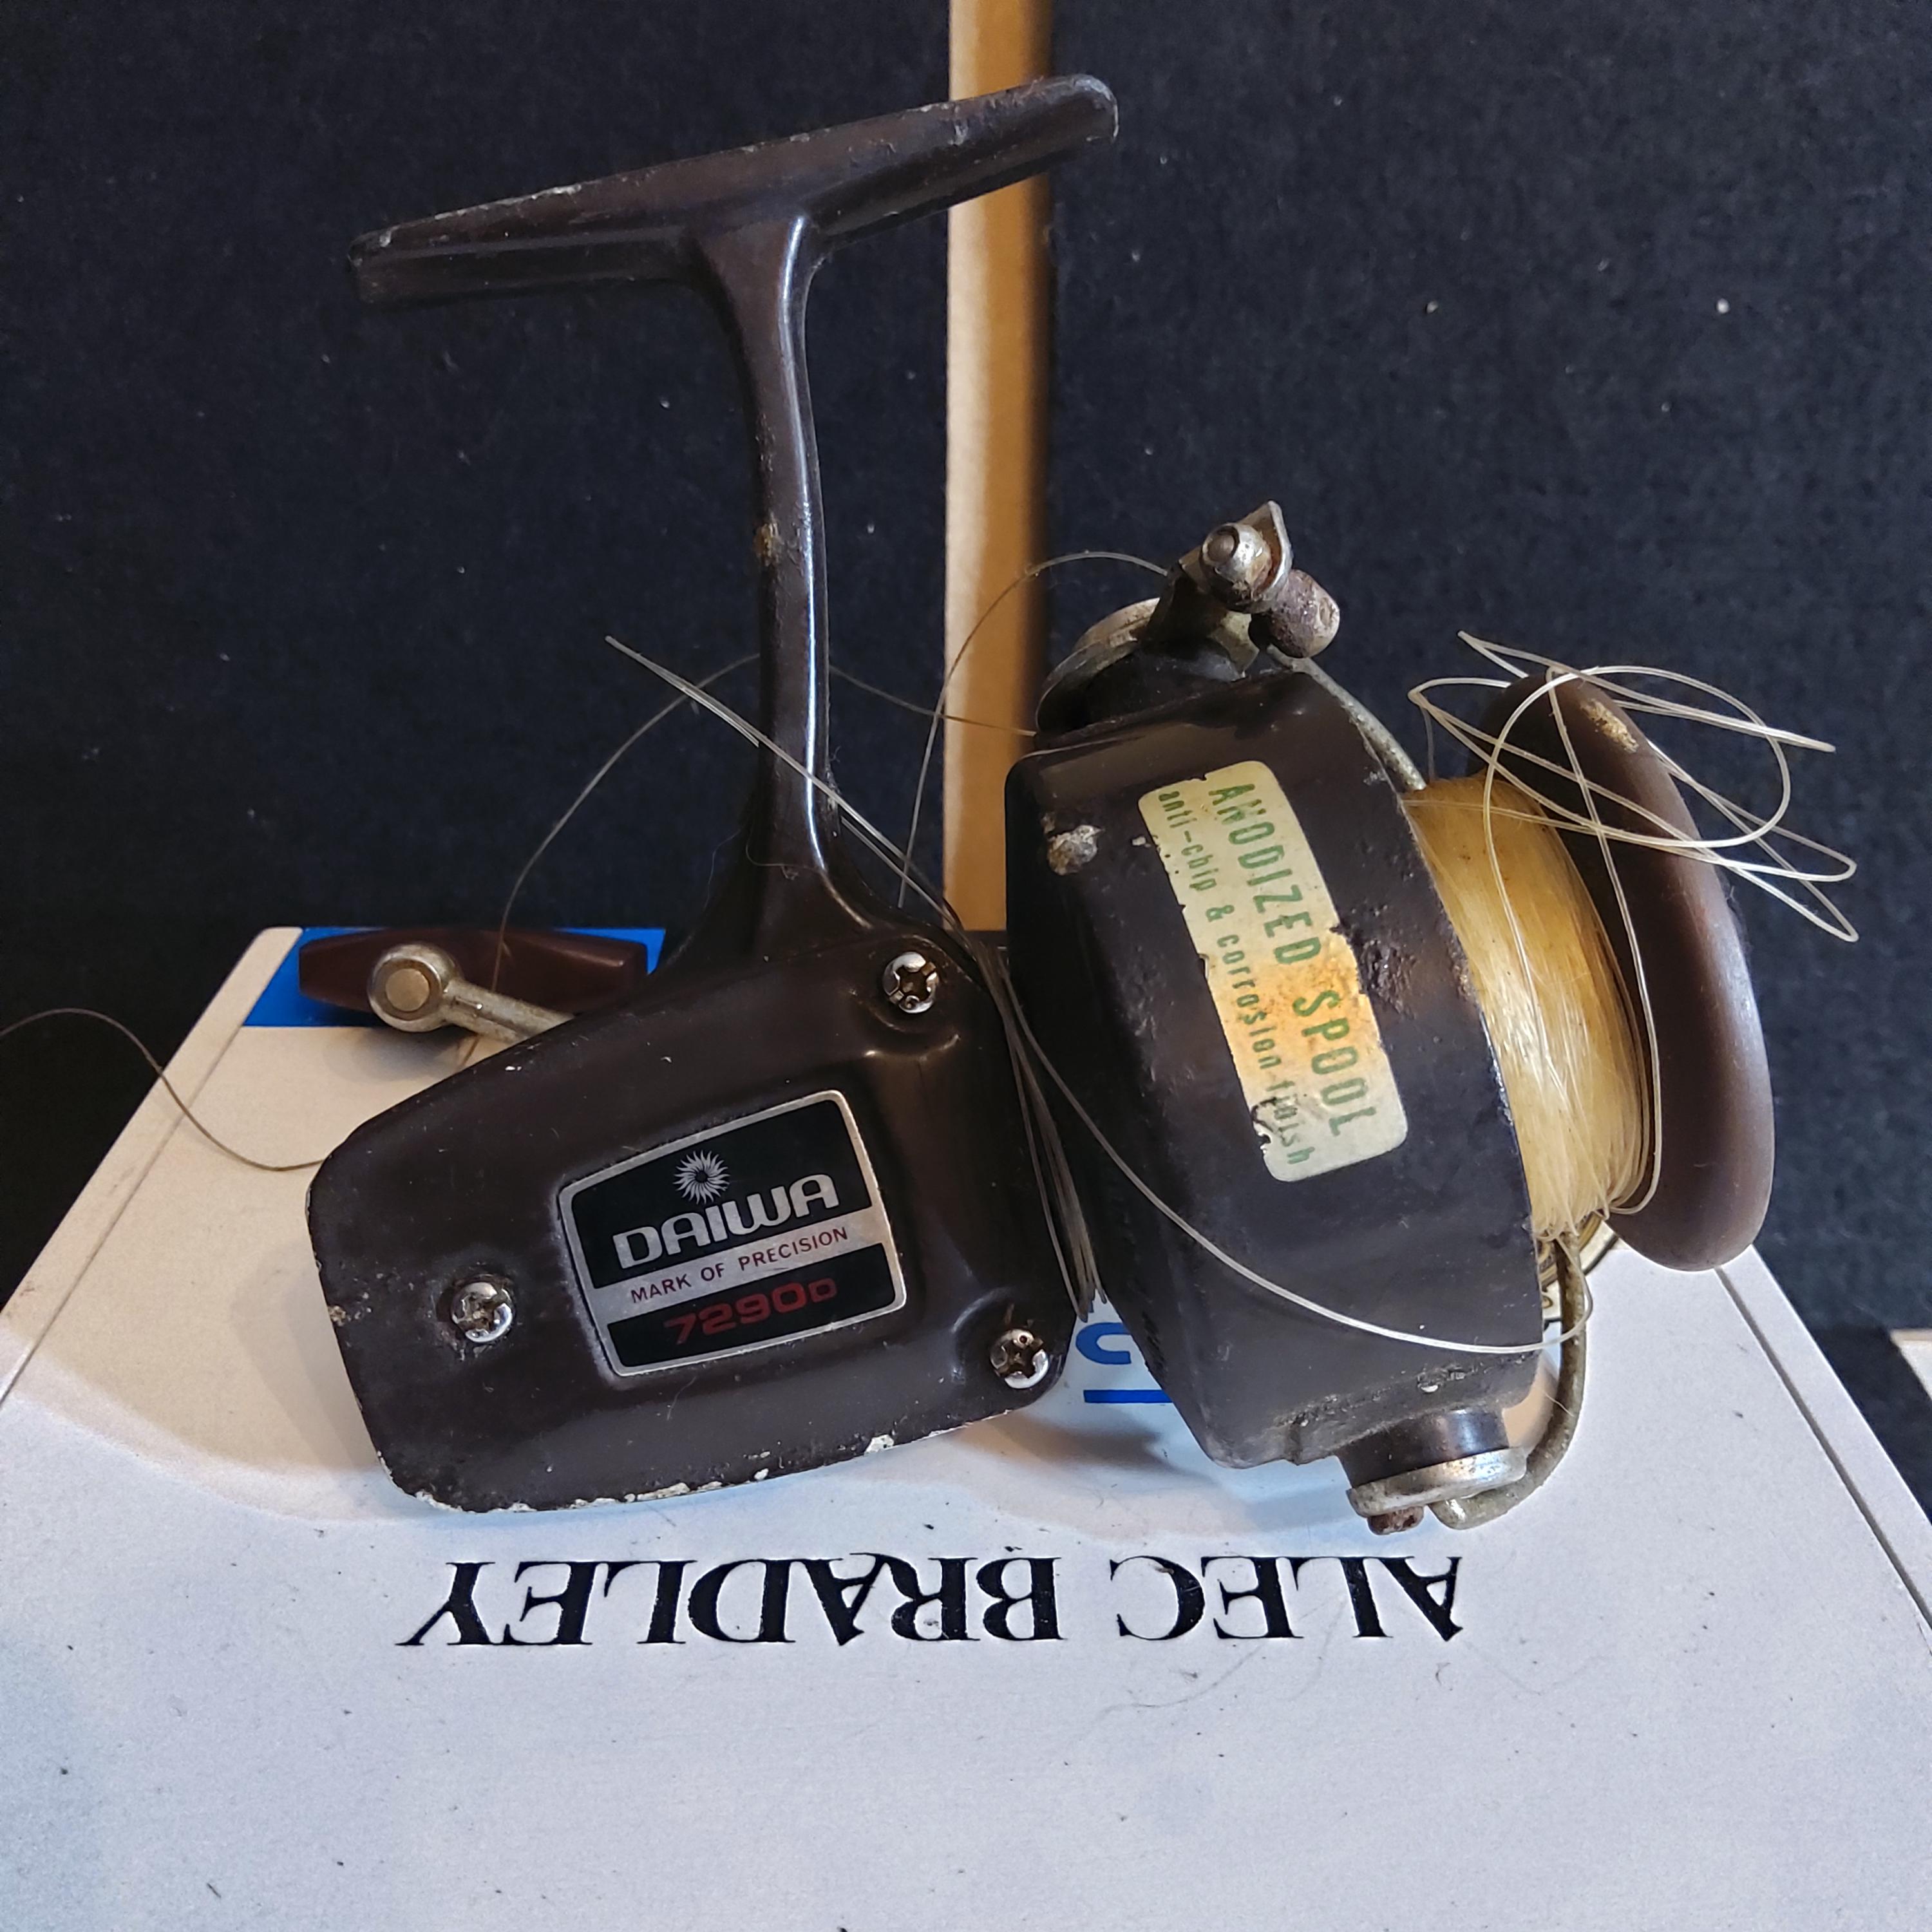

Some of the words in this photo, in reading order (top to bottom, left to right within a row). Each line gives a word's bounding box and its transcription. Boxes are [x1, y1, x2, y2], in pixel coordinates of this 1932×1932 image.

[1158, 790, 1218, 891] anti-chip
[1206, 904, 1235, 922] &
[1209, 784, 1321, 965] ANODIZED
[1292, 990, 1377, 1136] SPOOL
[1217, 934, 1282, 1070] corrosion
[1267, 1081, 1316, 1165] finish
[612, 1173, 839, 1269] DAIWA
[630, 1274, 690, 1303] MARK
[701, 1262, 724, 1282] OF
[739, 1227, 848, 1271] PRECISION
[395, 1553, 1068, 1646] BRADLEY
[1110, 1555, 1463, 1642] ALEC
